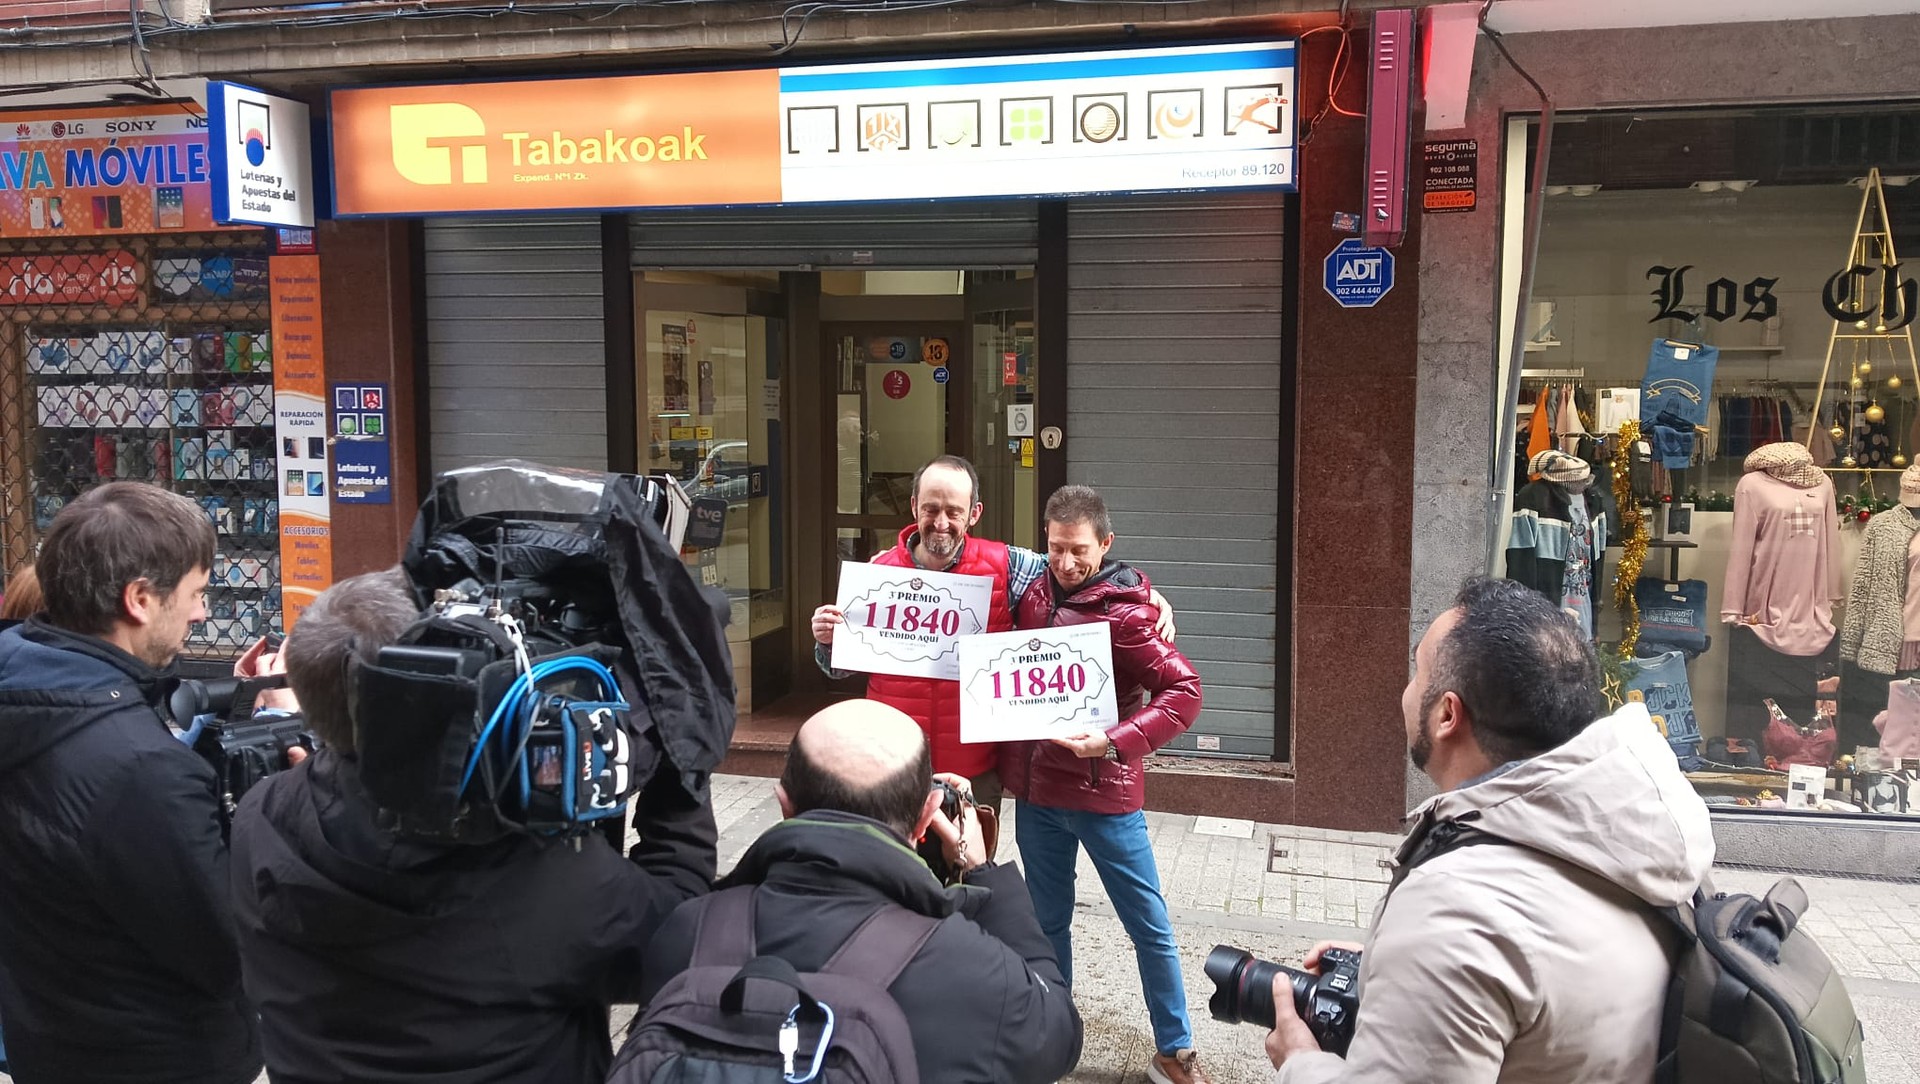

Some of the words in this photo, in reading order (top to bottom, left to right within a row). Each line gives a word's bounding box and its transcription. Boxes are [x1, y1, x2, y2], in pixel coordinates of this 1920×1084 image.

[68, 124, 84, 134] LG
[105, 120, 156, 132] SONY
[502, 126, 708, 166] Tabakoak
[0, 151, 53, 190] VA
[65, 137, 211, 187] MÓVILE
[1242, 163, 1285, 176] 89.120
[276, 176, 282, 188] y
[514, 173, 552, 182] Expend.
[1426, 177, 1474, 186] CONECTADA
[242, 184, 281, 200] Apuestas
[283, 188, 296, 202] del
[242, 199, 272, 212] Estado
[1337, 258, 1382, 280] ADT
[57, 272, 90, 281] Mney
[1646, 265, 1780, 324] Los
[1822, 262, 1918, 332] Ch
[370, 466, 376, 474] y
[338, 476, 374, 486] Apuestas
[375, 476, 388, 486] del
[696, 507, 722, 520] tve
[284, 526, 328, 536] ACCESORIOS
[898, 592, 940, 604] PREMIO
[862, 602, 960, 636] 11840
[879, 630, 916, 640] VENDIDO
[918, 634, 939, 643] AQUÍ
[1018, 652, 1061, 664] PREMIO
[990, 663, 1086, 698] 11840
[1008, 697, 1046, 706] VENDIDO
[1048, 694, 1069, 704] AQUÍ
